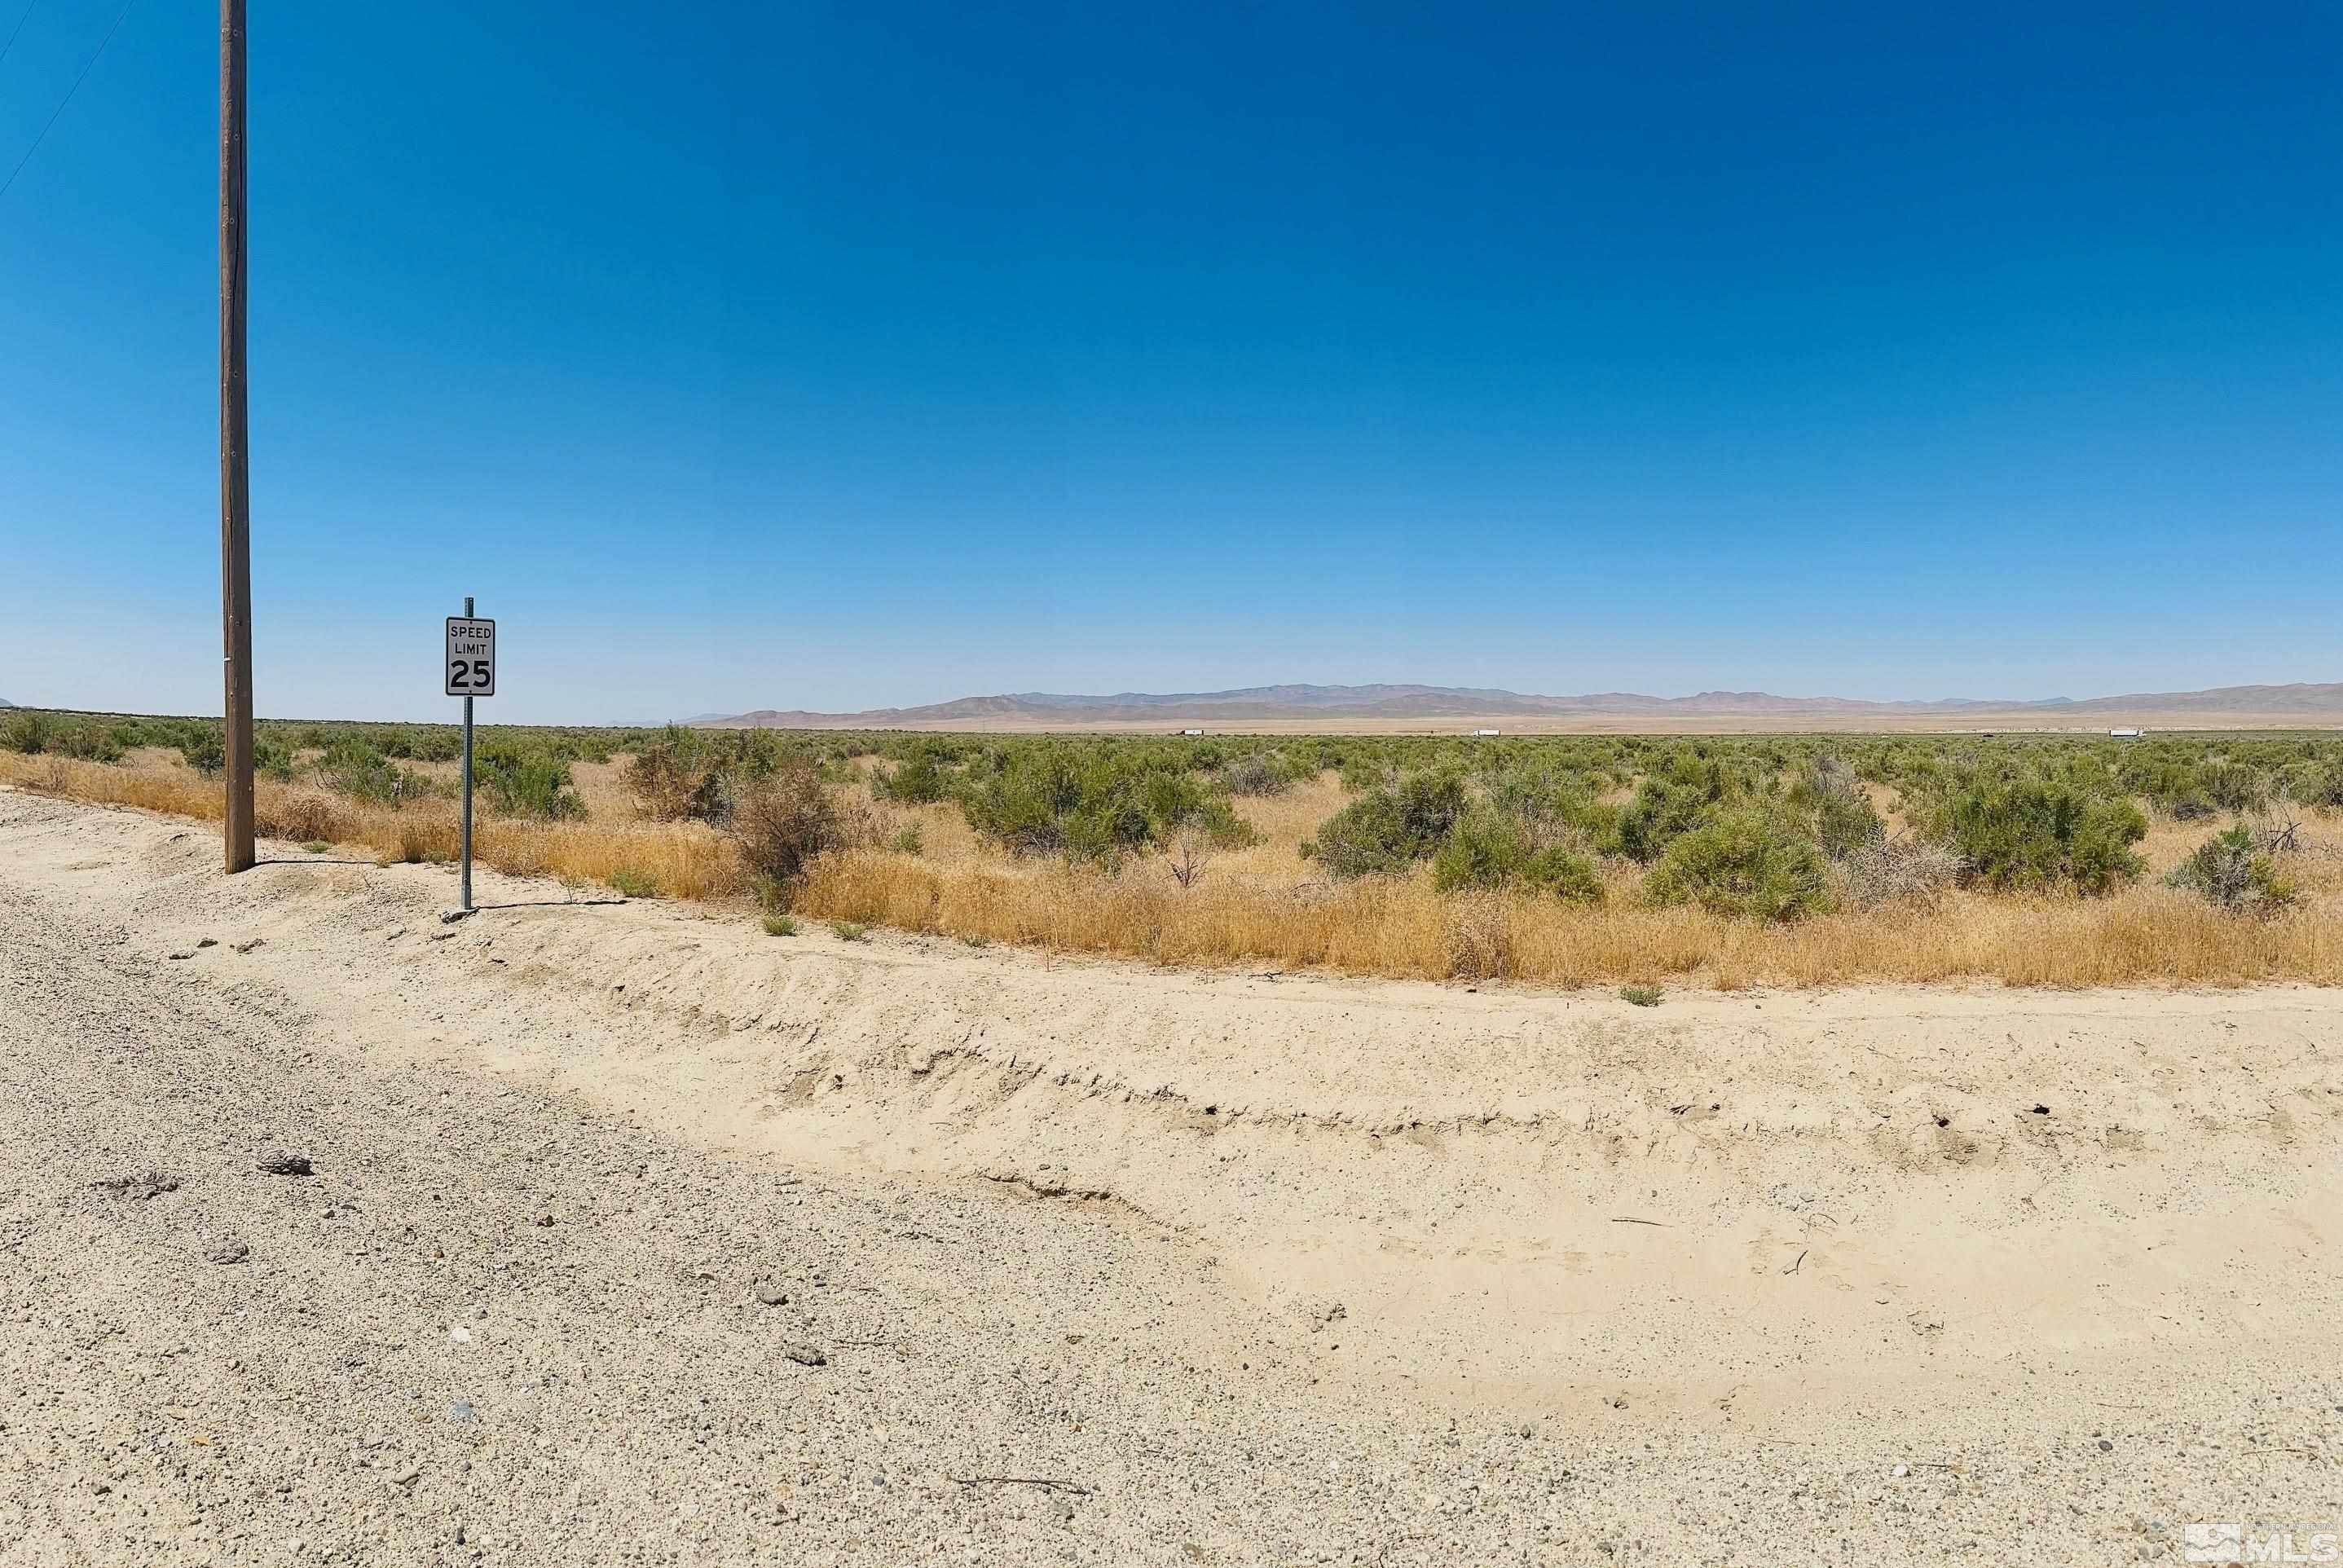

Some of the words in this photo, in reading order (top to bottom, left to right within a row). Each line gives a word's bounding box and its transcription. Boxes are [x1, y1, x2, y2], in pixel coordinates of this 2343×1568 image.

[451, 626, 491, 639] SPEED
[455, 643, 487, 654] LIMIT
[451, 660, 491, 687] 25
